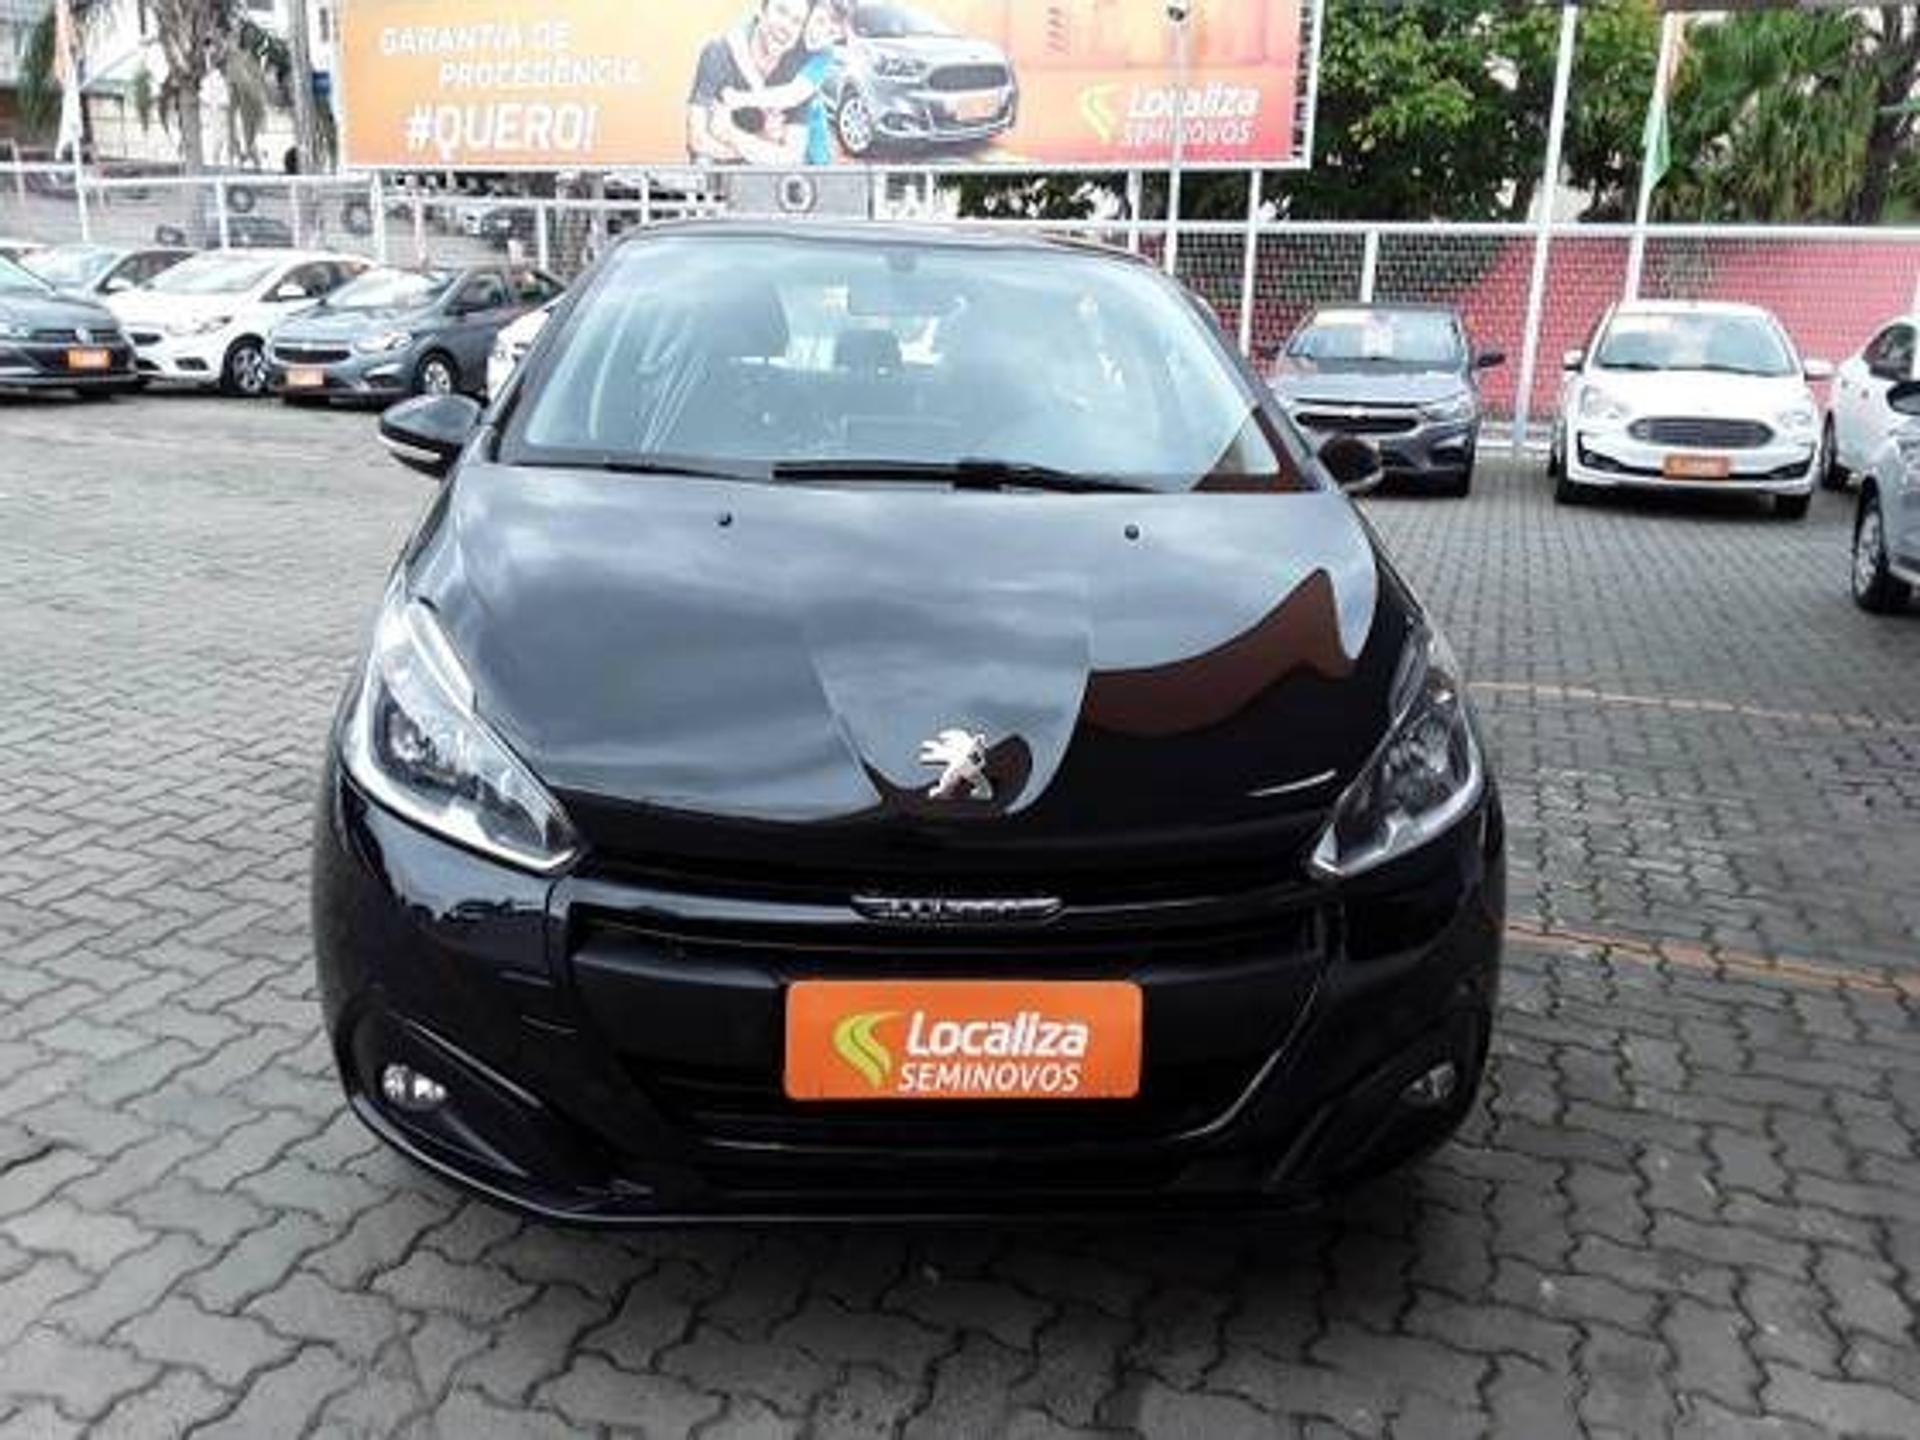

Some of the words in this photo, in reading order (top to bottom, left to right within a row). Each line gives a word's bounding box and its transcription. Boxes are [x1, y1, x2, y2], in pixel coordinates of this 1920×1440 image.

[409, 102, 598, 160] #QUERO!
[907, 1011, 1088, 1056] Localiza
[897, 1062, 1081, 1092] SEMINOVOS
